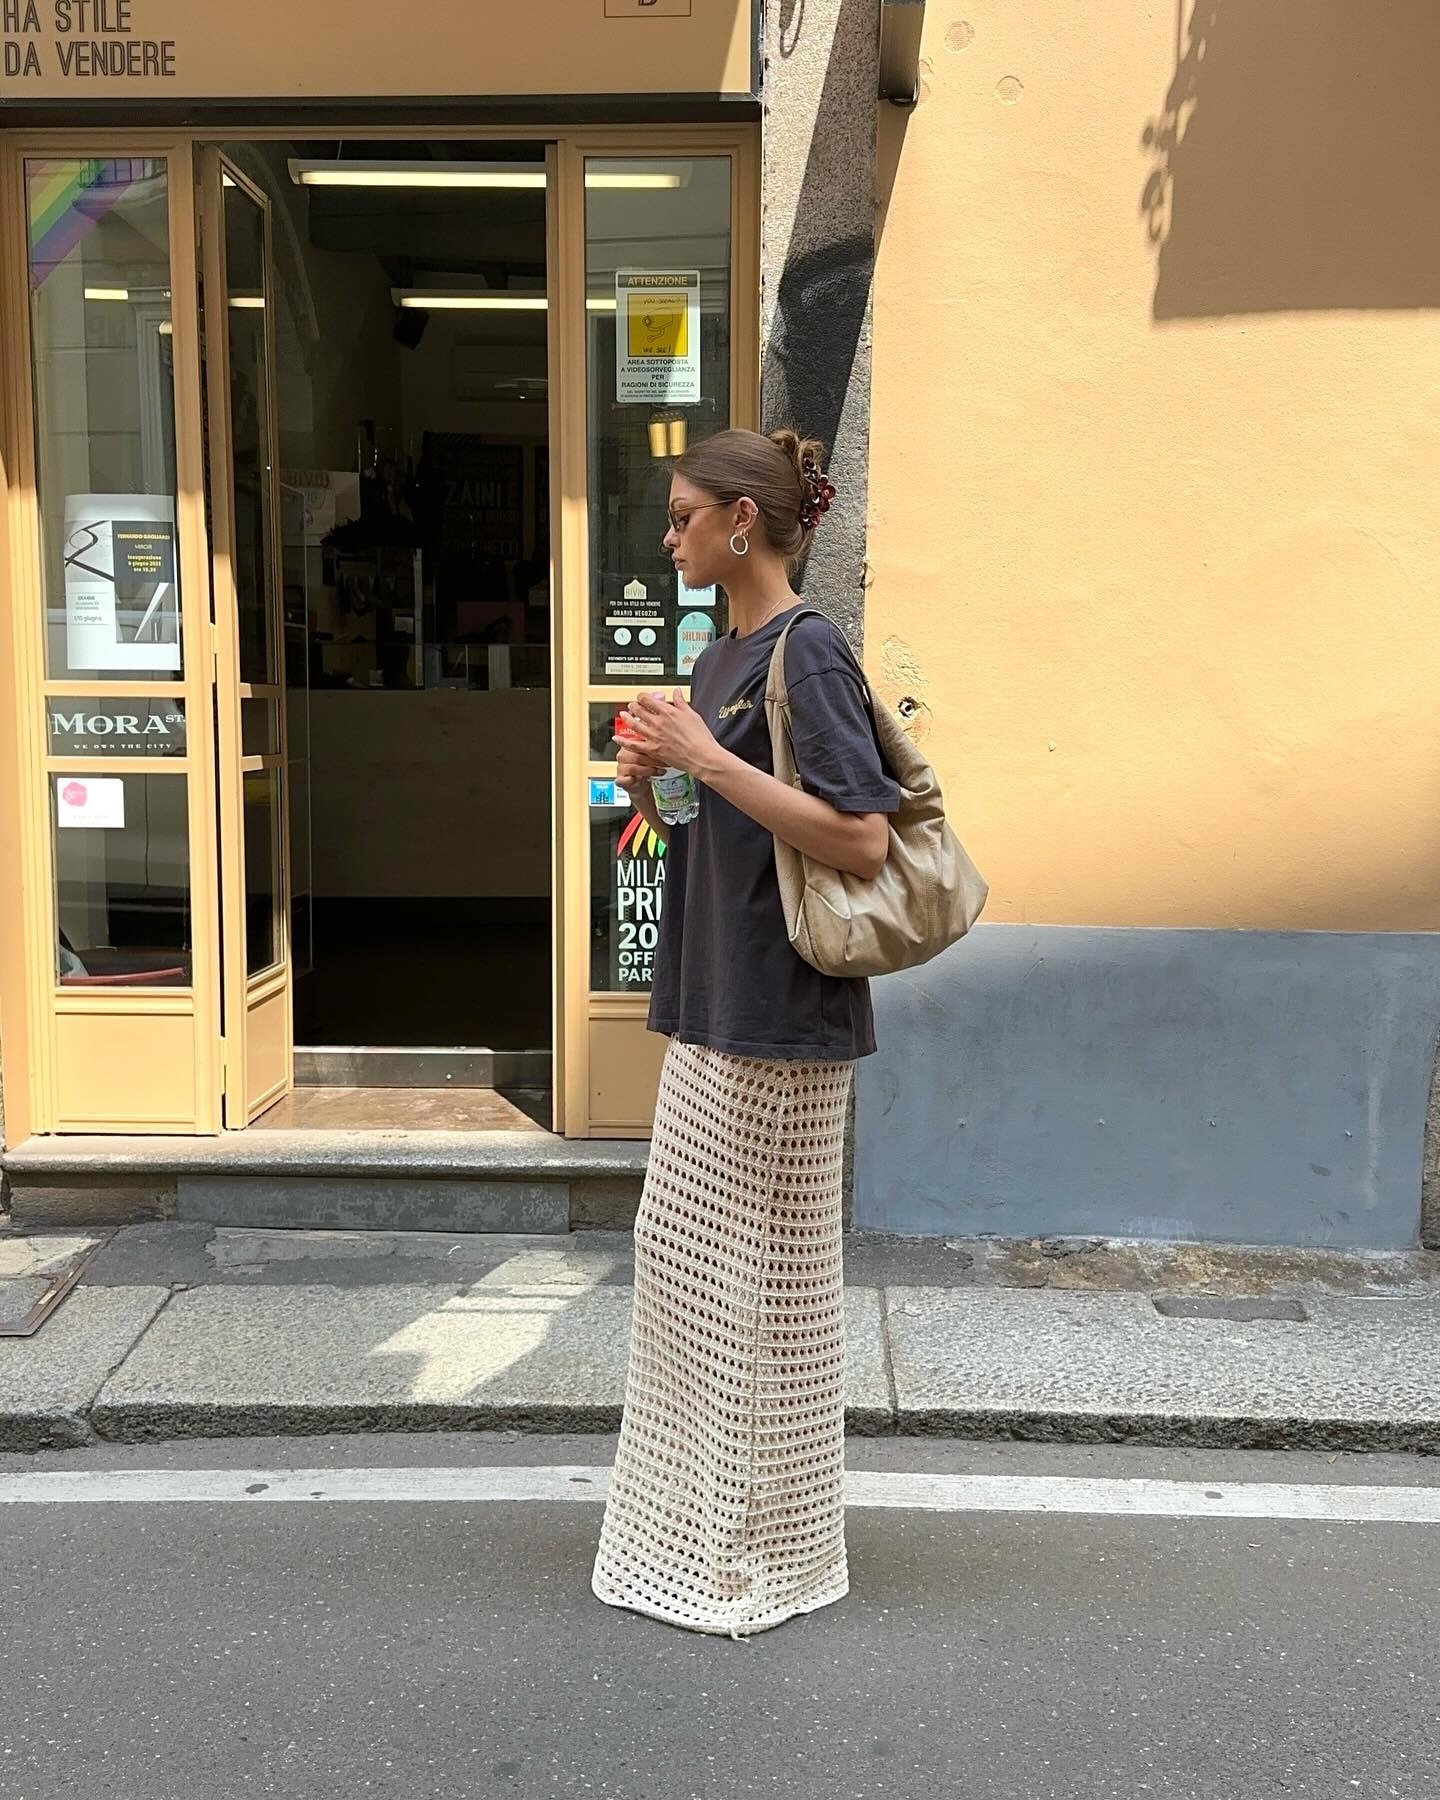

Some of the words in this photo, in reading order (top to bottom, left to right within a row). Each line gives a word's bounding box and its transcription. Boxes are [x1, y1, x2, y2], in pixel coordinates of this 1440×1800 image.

[3, 0, 41, 33] HA
[55, 0, 132, 33] STILE
[4, 41, 42, 76] DA
[55, 41, 176, 76] VENDERE
[627, 276, 688, 286] ATTENZIONE
[52, 712, 171, 735] MORA
[618, 922, 659, 949] 20
[618, 951, 656, 966] OFF
[618, 967, 655, 982] PAR
